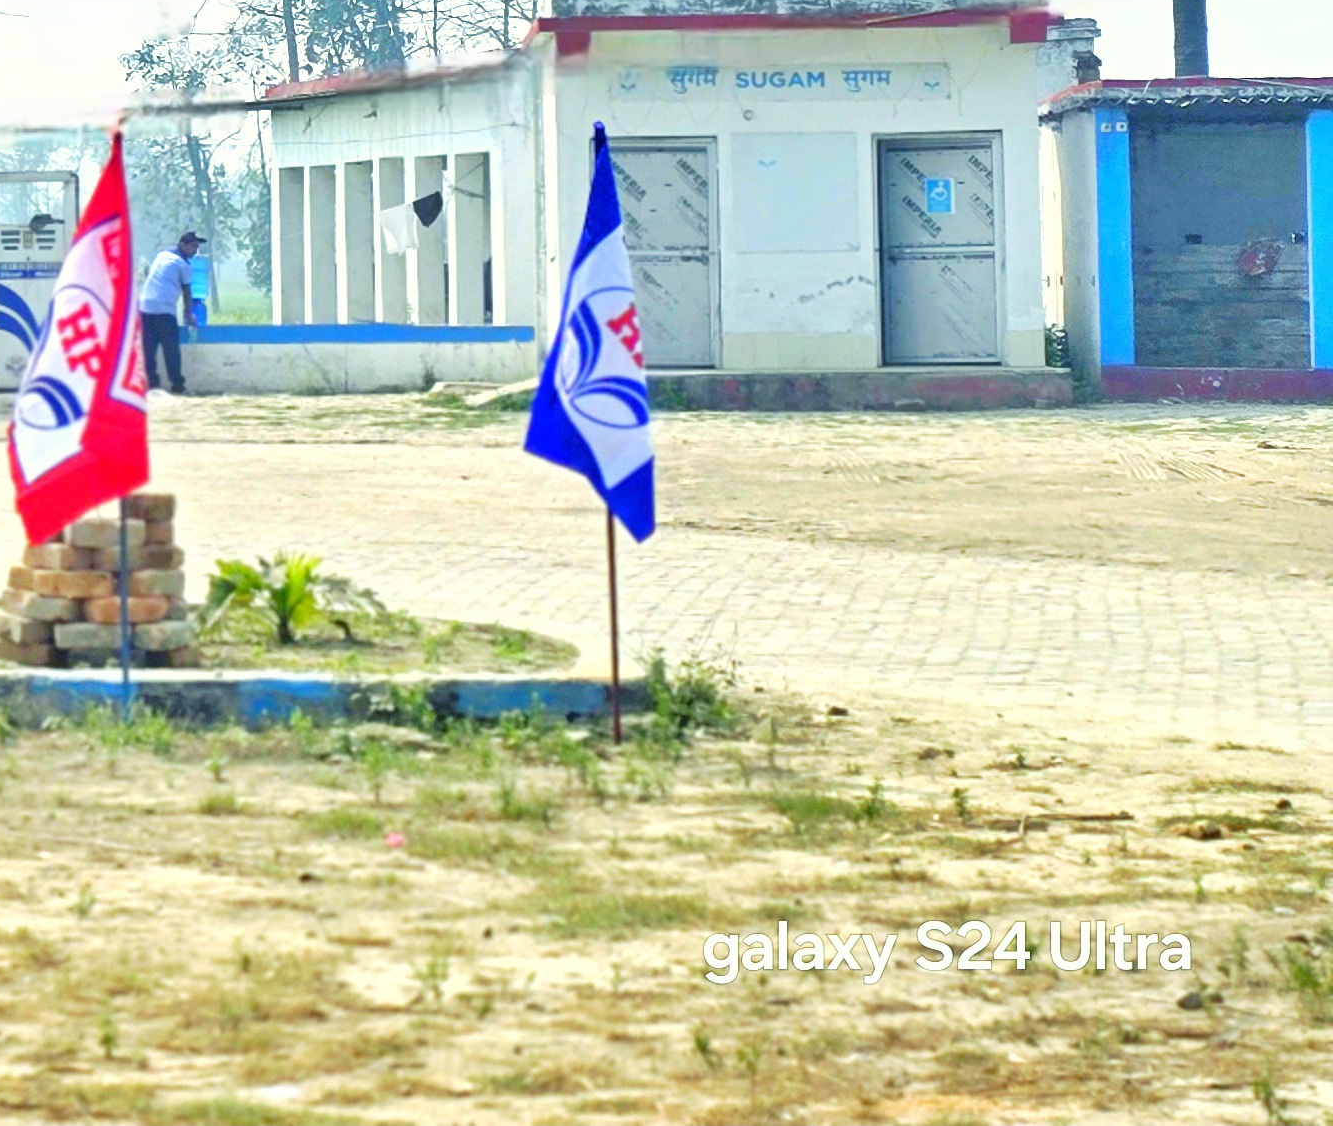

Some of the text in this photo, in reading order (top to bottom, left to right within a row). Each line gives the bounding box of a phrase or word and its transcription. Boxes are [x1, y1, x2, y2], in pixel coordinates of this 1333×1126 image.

[669, 66, 892, 94] सुगम SUGAM सुगम
[57, 302, 102, 380] HP
